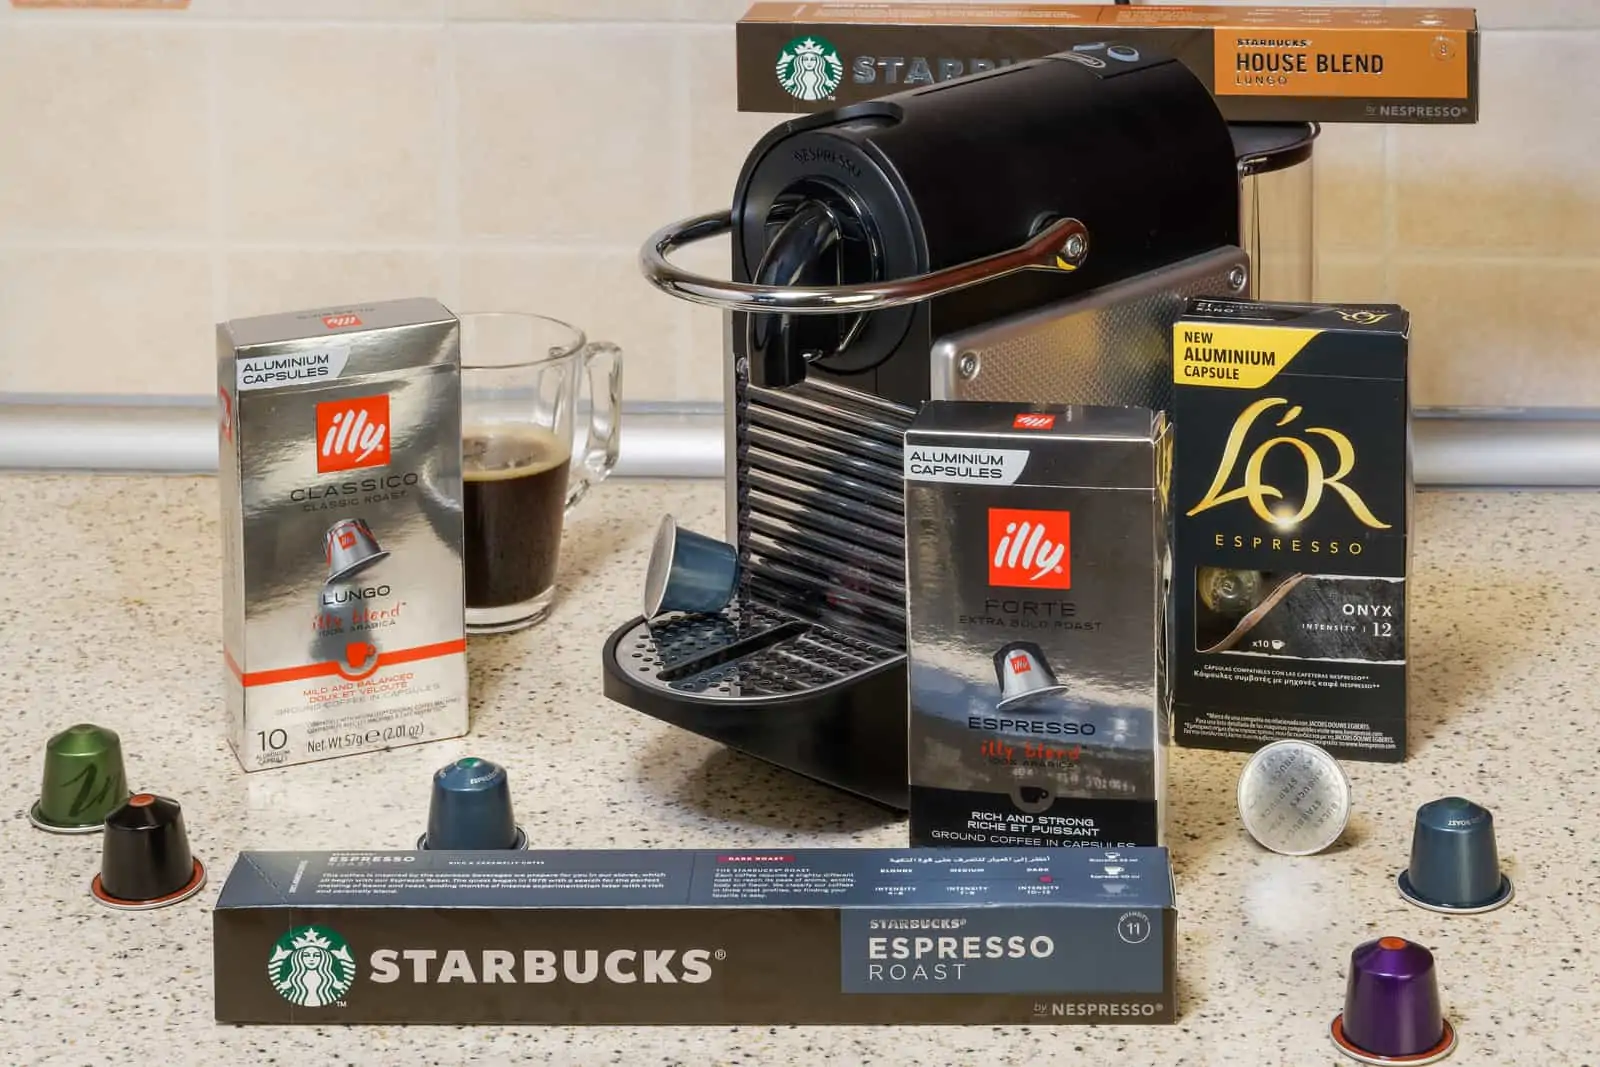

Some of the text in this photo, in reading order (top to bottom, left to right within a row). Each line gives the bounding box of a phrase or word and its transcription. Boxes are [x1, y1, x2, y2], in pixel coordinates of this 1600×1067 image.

[1237, 53, 1384, 75] HOUSE BLEND
[1235, 75, 1288, 87] LUNGO
[1184, 331, 1213, 344] NEW
[243, 354, 329, 373] ALUMINIUM
[1184, 347, 1275, 366] ALUMINIUM
[243, 366, 329, 385] CAPSULES
[1184, 365, 1239, 380] CAPSULE
[322, 409, 386, 463] illy
[910, 451, 1003, 466] ALUMINIUM
[910, 465, 1002, 479] CAPSULES
[290, 473, 419, 502] CLASSICO
[994, 521, 1065, 581] illy
[1214, 534, 1362, 555] ESPRESSO
[322, 585, 391, 605] LUNGO
[985, 598, 1076, 618] FORTE
[1342, 603, 1393, 617] ONYX
[959, 615, 1103, 632] EXTRA BOLD ROAST
[1302, 621, 1392, 637] INTENSITY 12
[303, 672, 414, 697] MILD AND BALANCED
[309, 693, 338, 703] DOUX
[342, 691, 356, 699] ET
[968, 717, 1096, 735] ESPRESSO
[257, 728, 288, 751] 10
[307, 740, 325, 753] Net
[327, 737, 343, 750] Wt
[344, 734, 363, 747] 57g
[967, 820, 1100, 837] RICHE ET PUISSANT
[971, 811, 1095, 828] RICH AND STRONG
[931, 830, 987, 842] GROUND
[990, 835, 1041, 846] COFFEE
[1046, 838, 1059, 847] IN
[1126, 922, 1141, 936] 11
[868, 935, 1055, 960] ESPRESSO
[868, 963, 967, 981] ROAST
[1033, 1002, 1047, 1017] by
